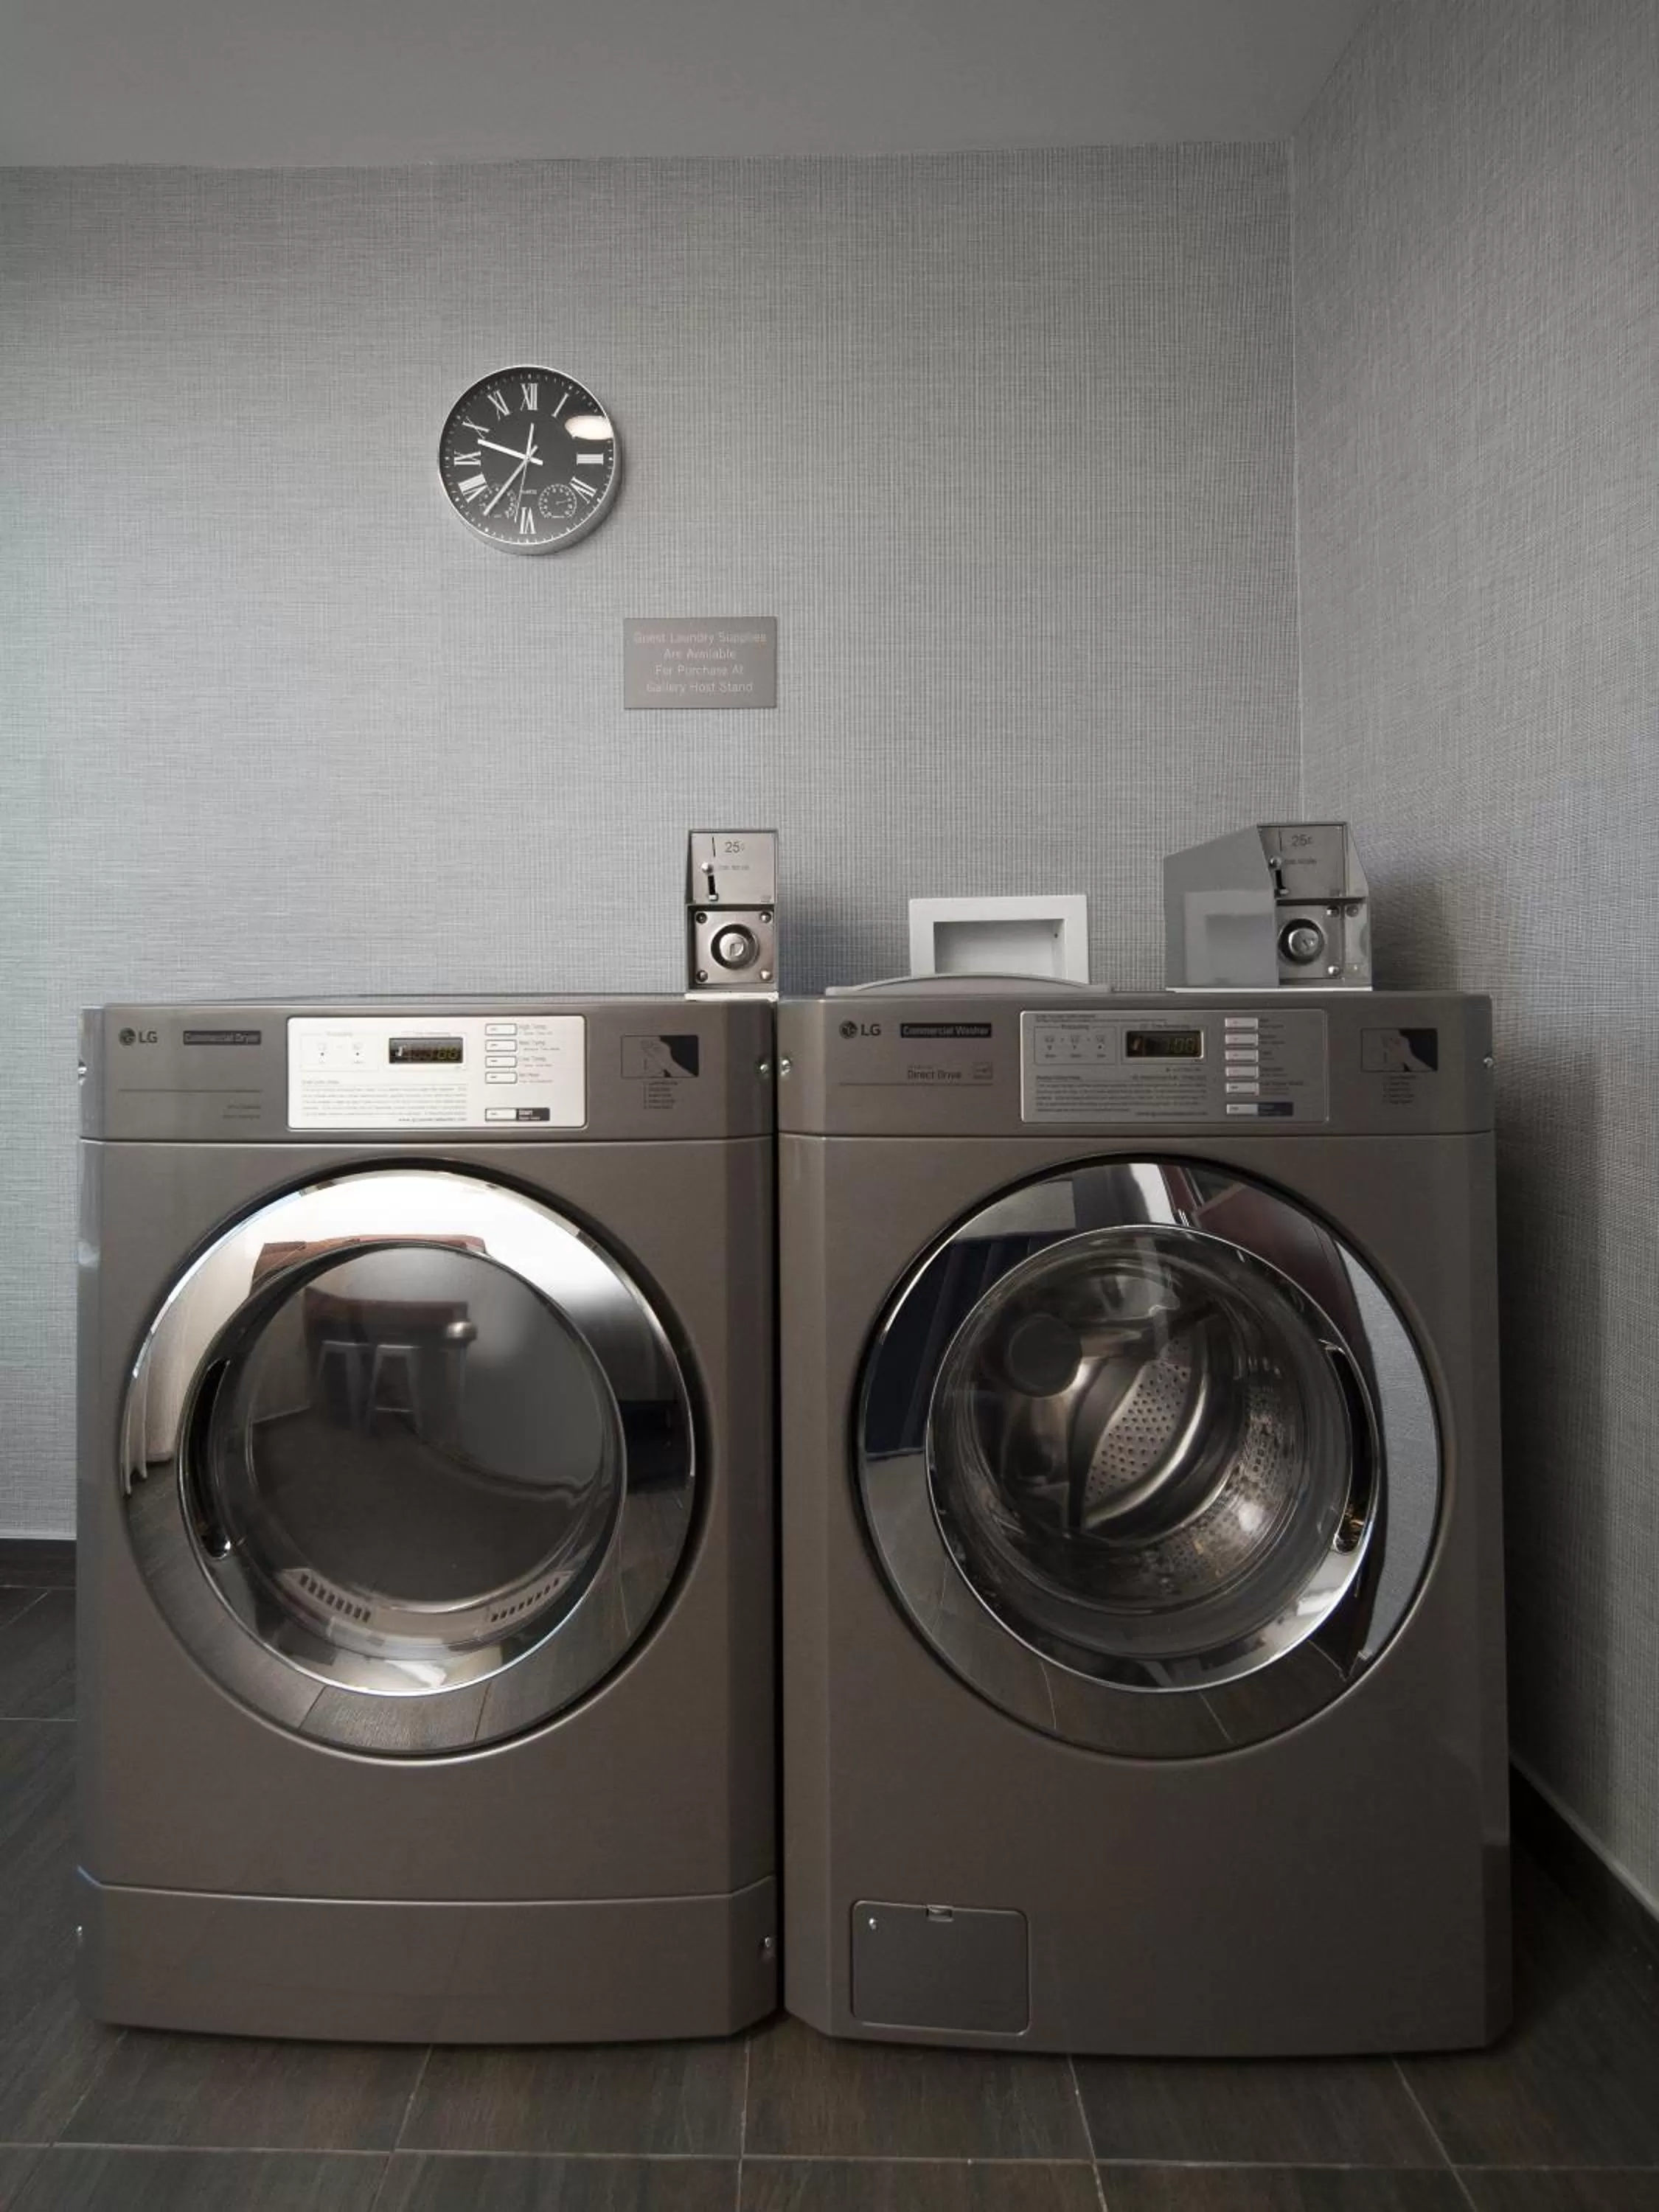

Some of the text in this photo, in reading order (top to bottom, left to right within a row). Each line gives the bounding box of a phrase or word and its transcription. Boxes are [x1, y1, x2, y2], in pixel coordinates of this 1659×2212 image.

[670, 630, 714, 647] Laundry
[664, 648, 737, 660] Are Available
[654, 664, 744, 675] For Purchase At
[718, 681, 754, 693] Stand
[860, 1023, 881, 1036] LG
[138, 1030, 158, 1043] LG
